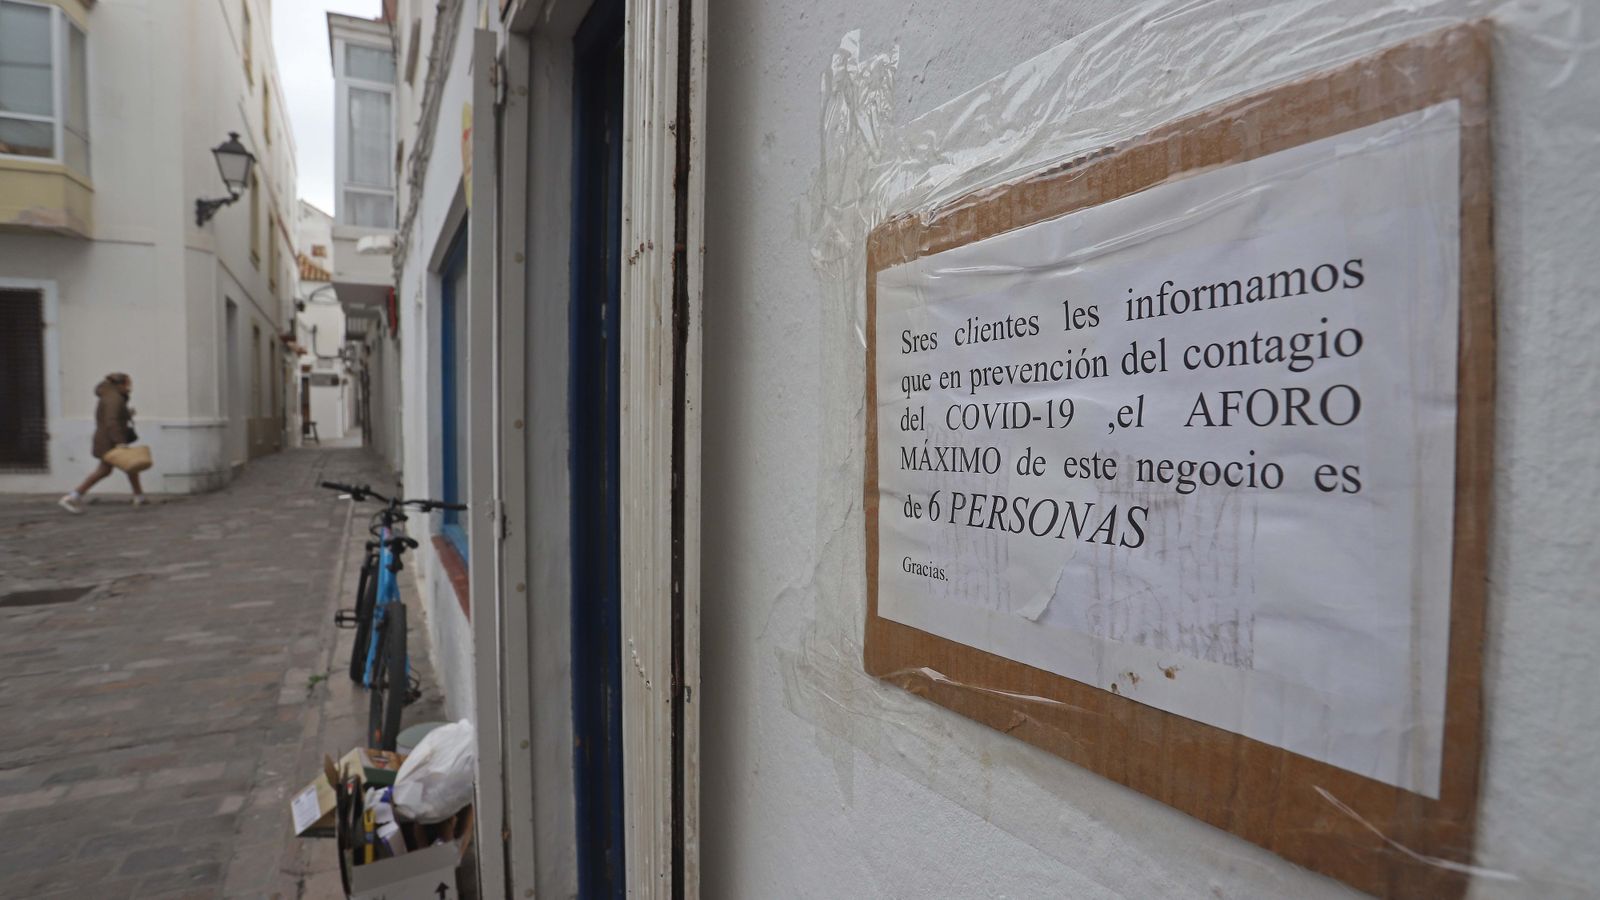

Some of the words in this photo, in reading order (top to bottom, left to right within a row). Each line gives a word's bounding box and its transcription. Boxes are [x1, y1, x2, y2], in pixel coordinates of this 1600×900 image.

[901, 329, 938, 355] Sres
[954, 314, 1040, 347] clientes
[1062, 299, 1100, 332] les
[1125, 258, 1365, 324] informamos
[901, 373, 932, 400] que
[939, 369, 962, 390] en
[969, 347, 1110, 396] prevención
[1121, 337, 1169, 376] del
[1183, 316, 1364, 373] contagio
[900, 405, 925, 432] del
[945, 398, 1075, 431] COVID-19
[1108, 394, 1145, 435] ,el
[1183, 384, 1362, 428] AFORO
[900, 438, 1002, 475] MÁXIMO
[1016, 446, 1047, 477] de
[1063, 451, 1117, 481] este
[1136, 449, 1284, 495] negocio
[1314, 464, 1362, 495] es
[903, 493, 923, 520] de
[928, 489, 941, 522] 6
[948, 491, 1150, 549] PERSONAS
[902, 556, 949, 582] Gracias.
